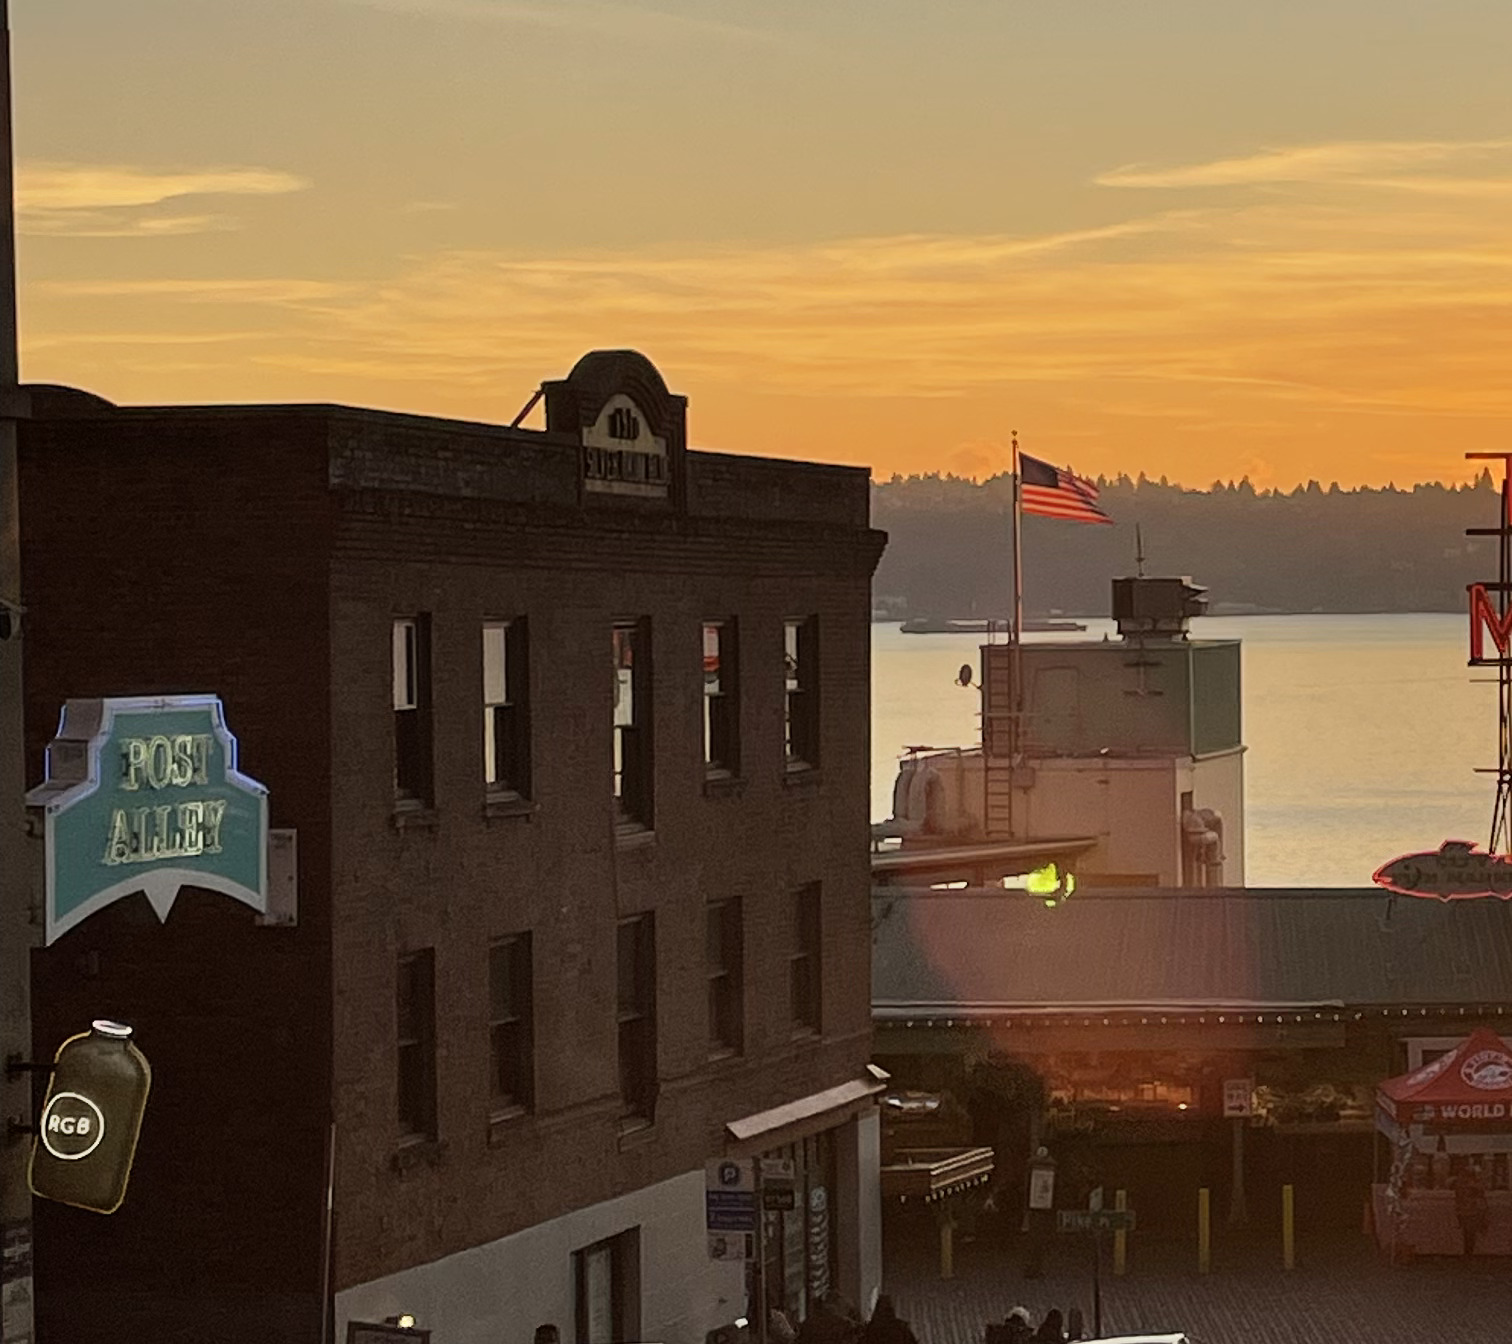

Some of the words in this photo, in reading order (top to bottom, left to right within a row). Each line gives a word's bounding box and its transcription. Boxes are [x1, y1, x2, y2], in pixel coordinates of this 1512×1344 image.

[119, 735, 214, 791] POST
[102, 799, 227, 866] ALLEY
[47, 1114, 91, 1136] RGB
[1441, 1103, 1505, 1119] WORLD
